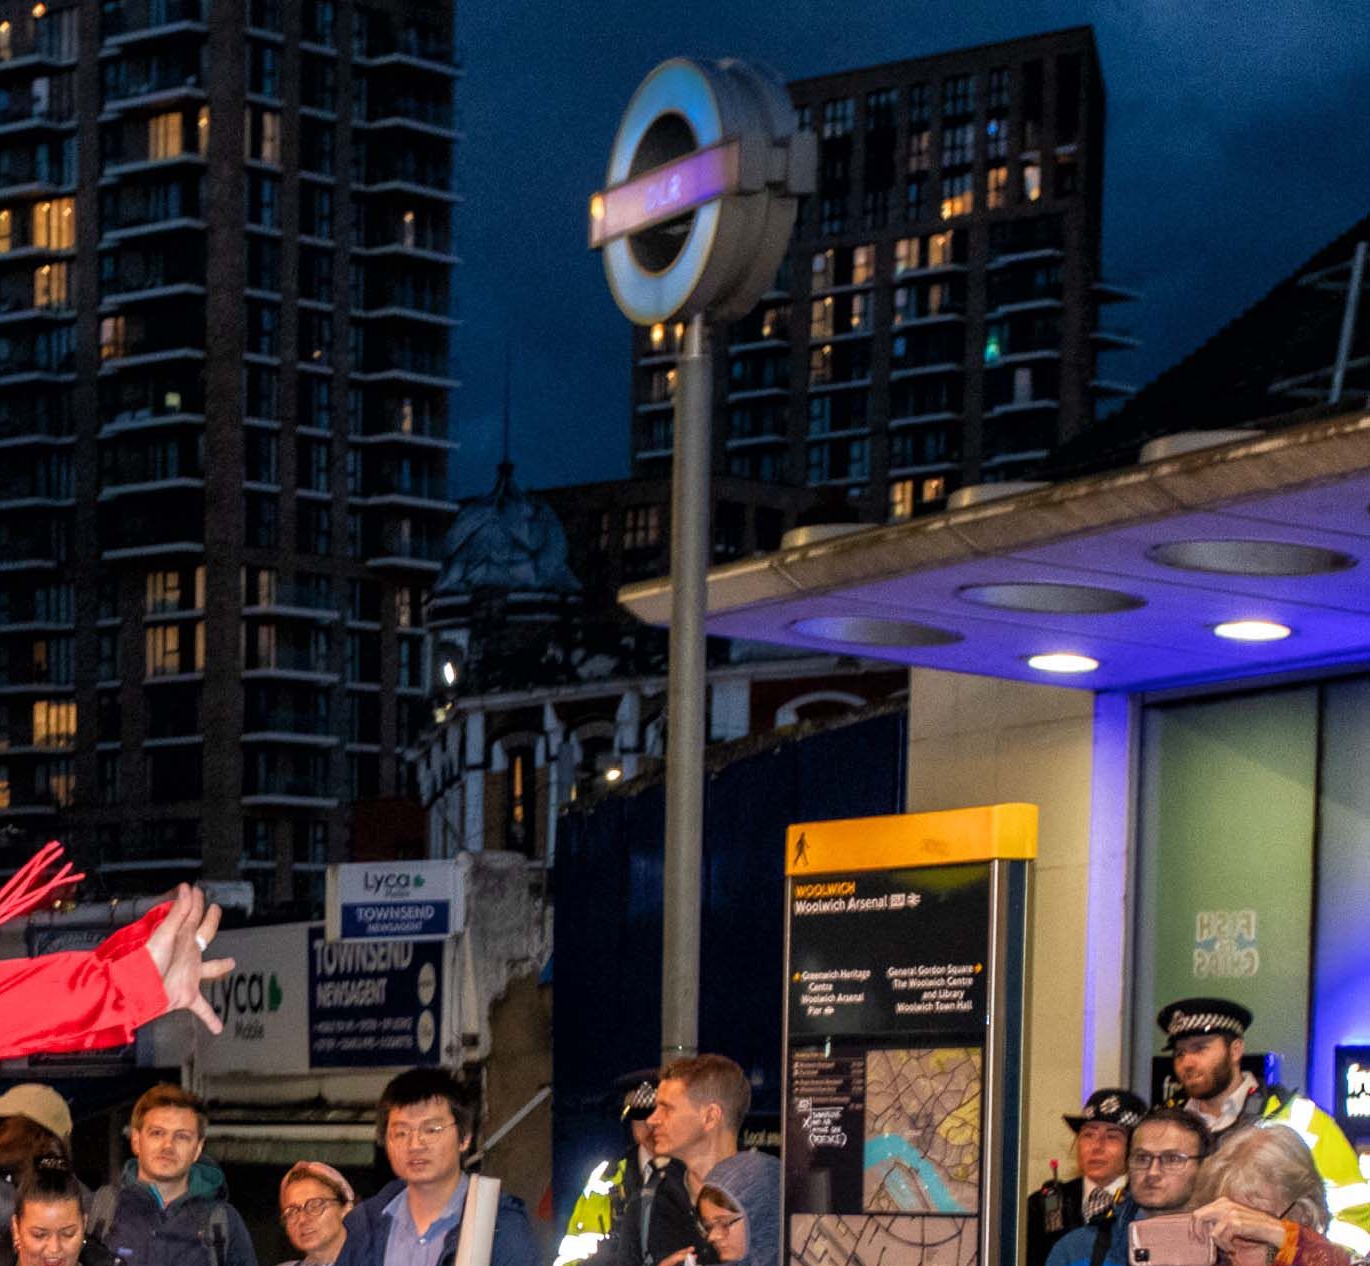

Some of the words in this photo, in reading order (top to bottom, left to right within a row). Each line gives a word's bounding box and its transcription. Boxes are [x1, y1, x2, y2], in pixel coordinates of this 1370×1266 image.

[364, 871, 411, 895] Lyca
[795, 881, 856, 899] WOOLWICH
[355, 904, 435, 922] TOWNSEND
[795, 897, 846, 915] Woolwich
[846, 894, 888, 912] Arsenal
[314, 938, 413, 976] TOWNSEND
[886, 966, 917, 978] General
[917, 965, 946, 977] Gordon
[946, 963, 974, 976] Square
[893, 979, 908, 990] The
[908, 978, 946, 990] Woolwich
[946, 976, 974, 987] Centre
[801, 992, 836, 1005] Woolwich
[837, 991, 865, 1003] Arsenal
[922, 990, 938, 1000] and
[938, 988, 965, 1001] Library
[896, 1002, 934, 1015] Woolwich
[934, 1001, 956, 1012] Town
[956, 999, 973, 1011] Hall
